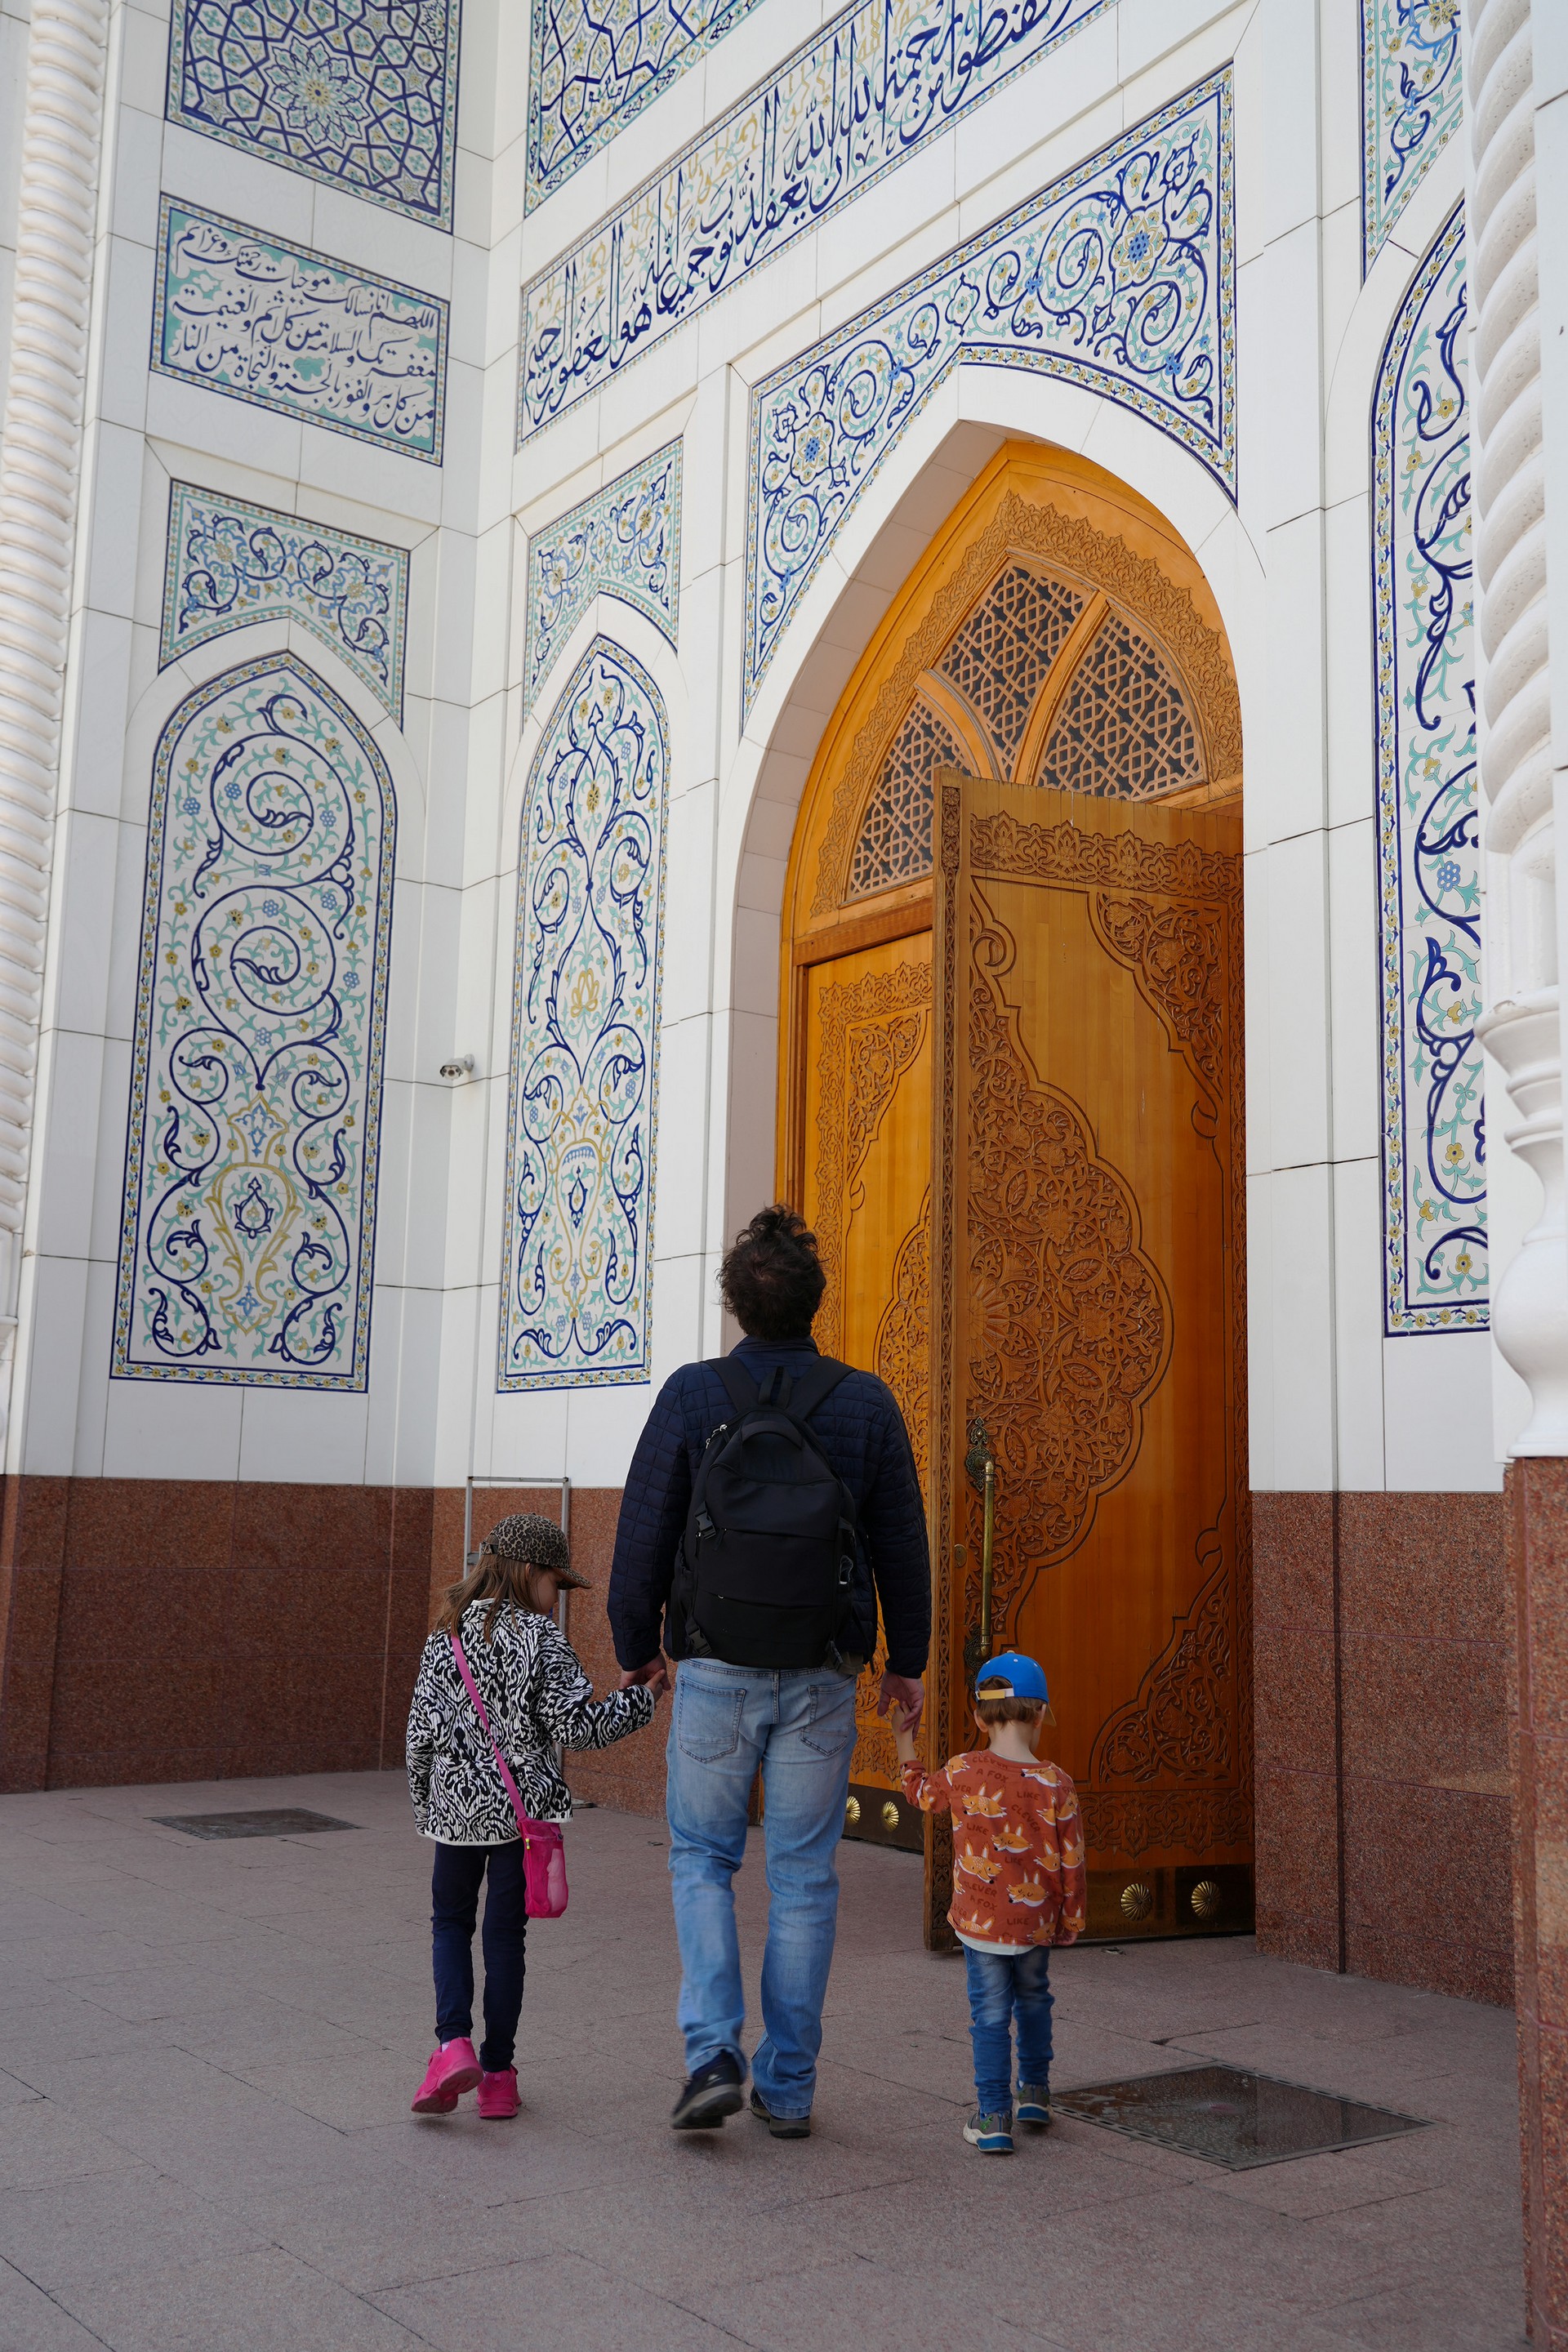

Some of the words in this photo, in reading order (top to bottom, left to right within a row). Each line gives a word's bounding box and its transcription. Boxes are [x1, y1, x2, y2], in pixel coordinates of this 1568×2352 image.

[987, 1770, 1009, 1783] FOX
[1017, 1790, 1040, 1801] LIKE
[1011, 1803, 1040, 1833] CLEVER
[966, 1822, 989, 1835] LIKE
[978, 1898, 997, 1911] FOX
[1006, 1918, 1030, 1926] LIKE
